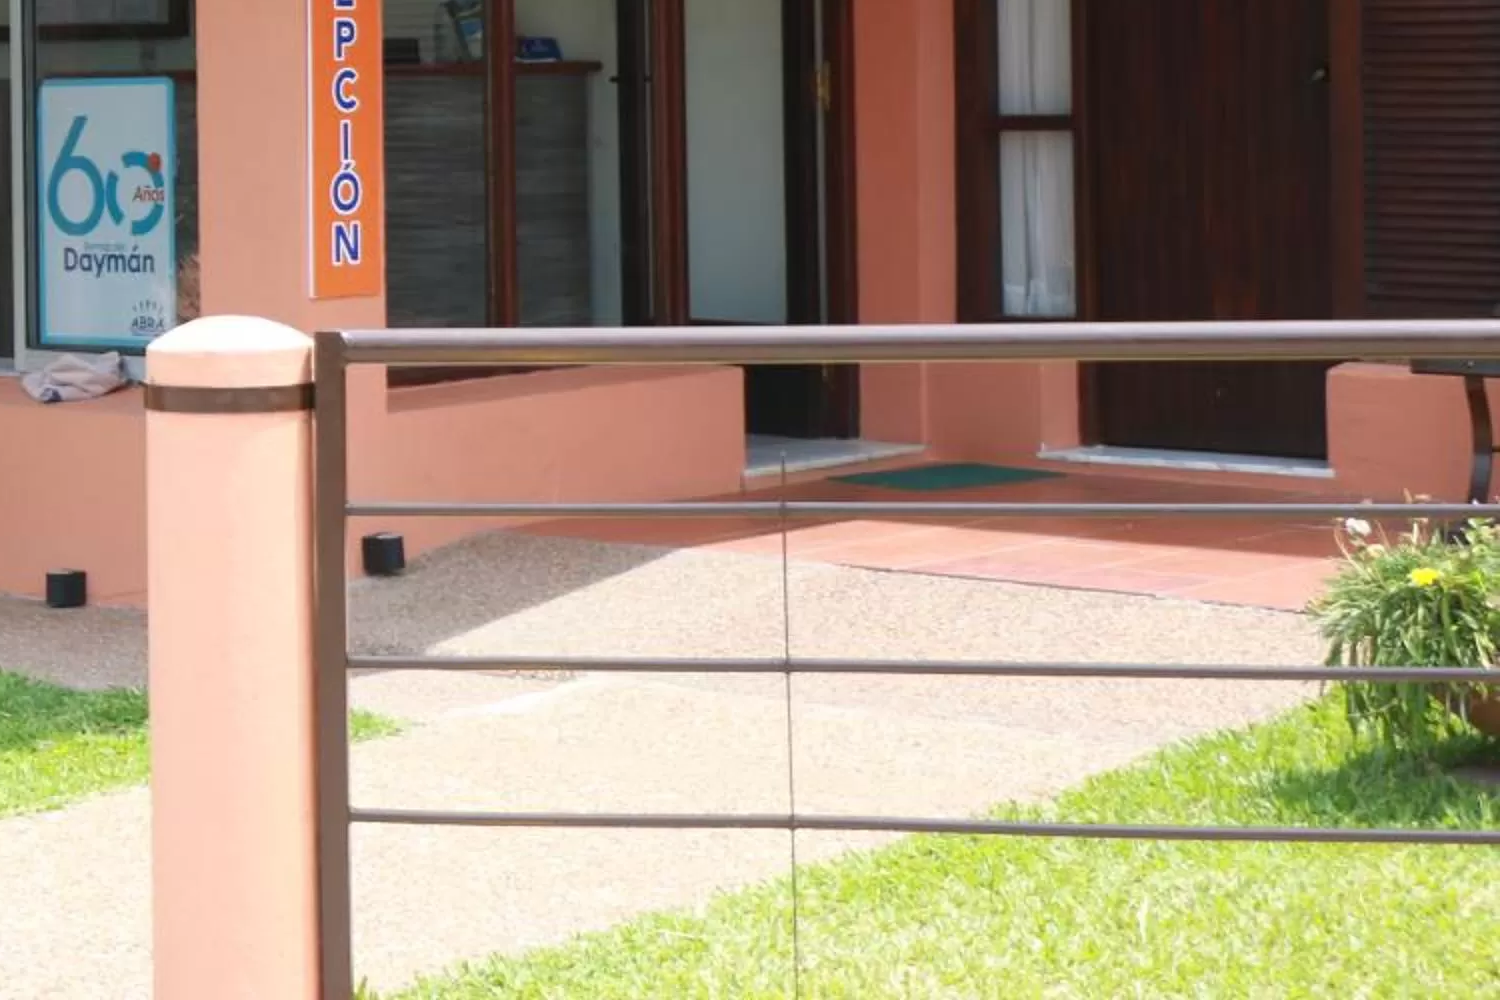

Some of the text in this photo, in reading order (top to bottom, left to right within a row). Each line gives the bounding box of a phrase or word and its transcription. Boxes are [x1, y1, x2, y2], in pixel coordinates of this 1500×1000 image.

[46, 113, 165, 237] 60
[131, 184, 165, 203] Años
[63, 245, 155, 278] Daymán
